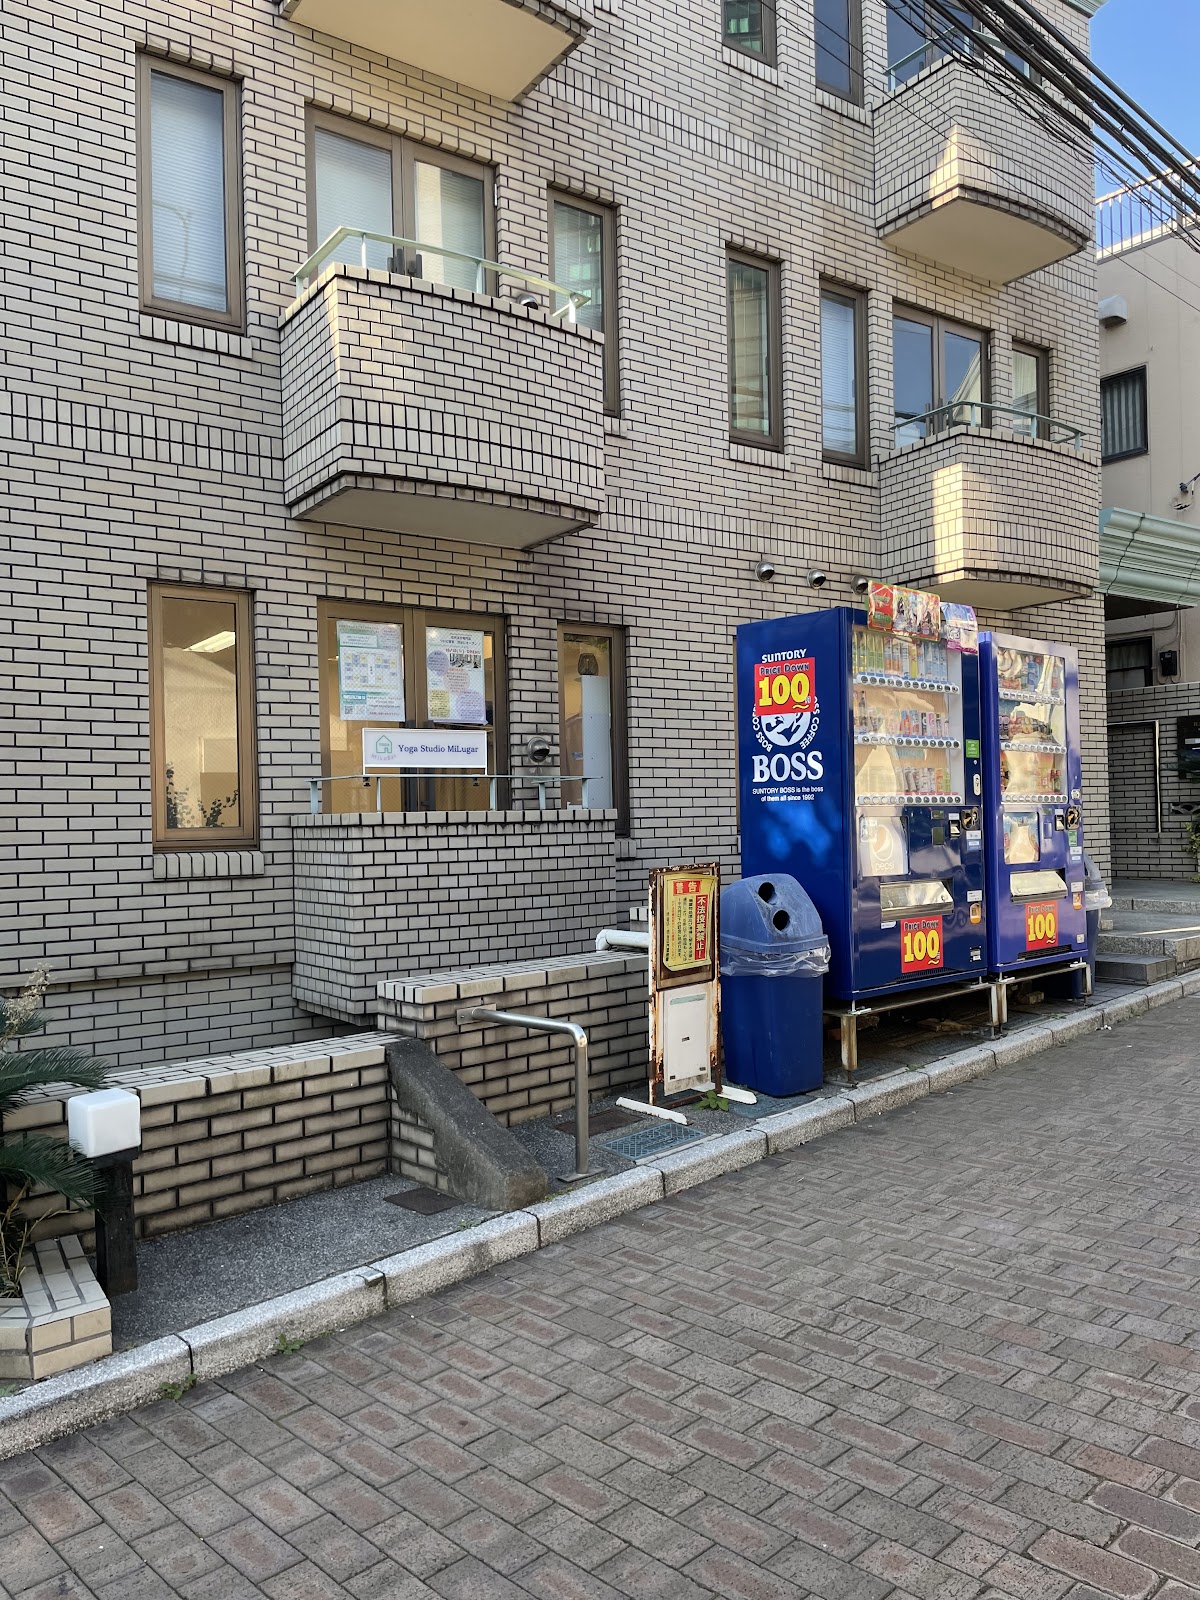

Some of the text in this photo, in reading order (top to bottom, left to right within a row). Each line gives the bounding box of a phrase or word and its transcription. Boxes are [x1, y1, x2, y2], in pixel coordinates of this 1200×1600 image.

[762, 649, 806, 663] SUNTORY
[784, 663, 810, 673] DOWN
[800, 717, 820, 750] COFFEE
[398, 745, 479, 754] Yoga Studio MiLugar
[752, 751, 823, 782] BOSS
[675, 881, 698, 894] 警告
